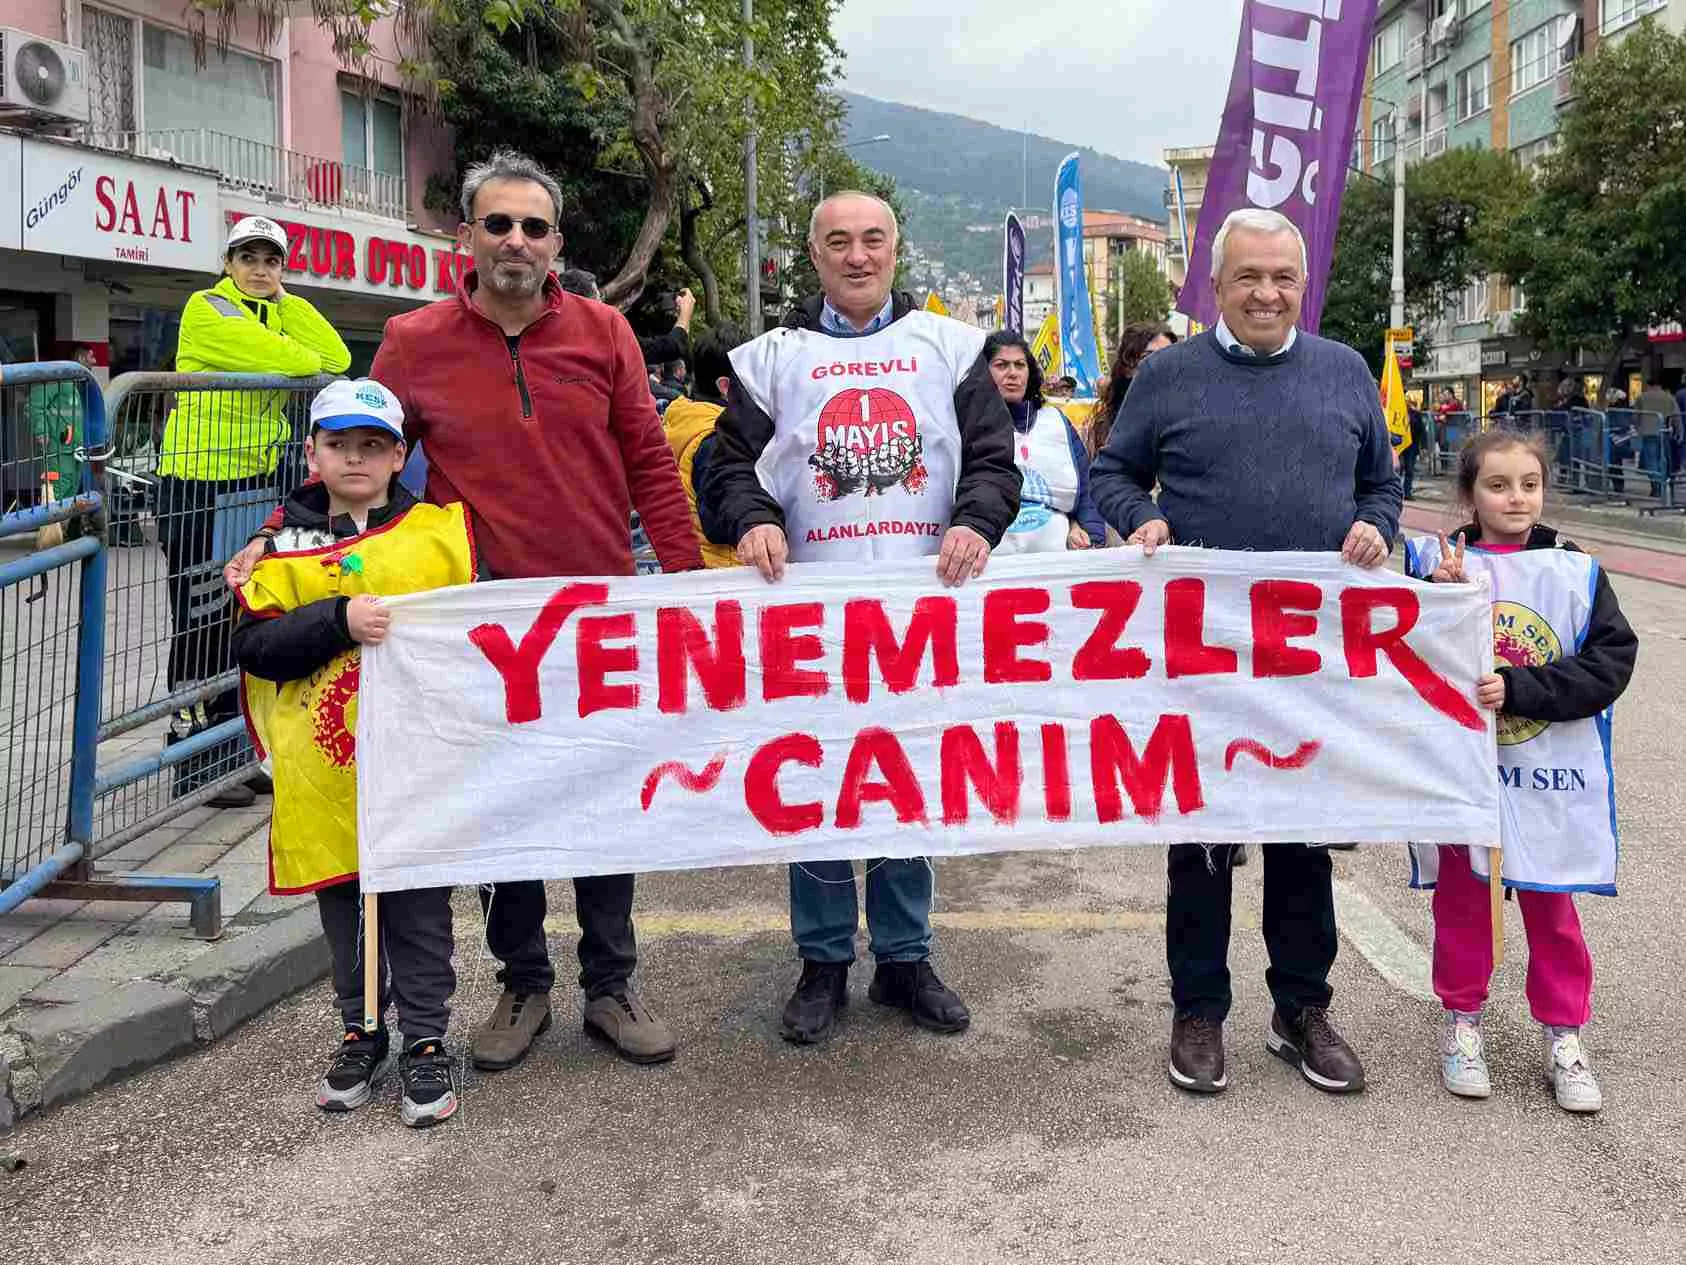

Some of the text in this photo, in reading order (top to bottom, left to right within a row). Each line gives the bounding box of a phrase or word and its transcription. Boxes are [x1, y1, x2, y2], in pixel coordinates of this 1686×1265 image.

[26, 167, 83, 229] Güngör
[95, 175, 196, 244] SAAT
[115, 245, 149, 262] TAMİRİ
[367, 236, 426, 289] OTO
[811, 356, 918, 380] GÖREVLİ
[859, 394, 871, 422] 1
[824, 420, 911, 450] MAYIS
[806, 520, 942, 543] ALANLARDAYIZ
[467, 576, 1488, 733] YENEMEZLER
[1532, 767, 1586, 792] SEN
